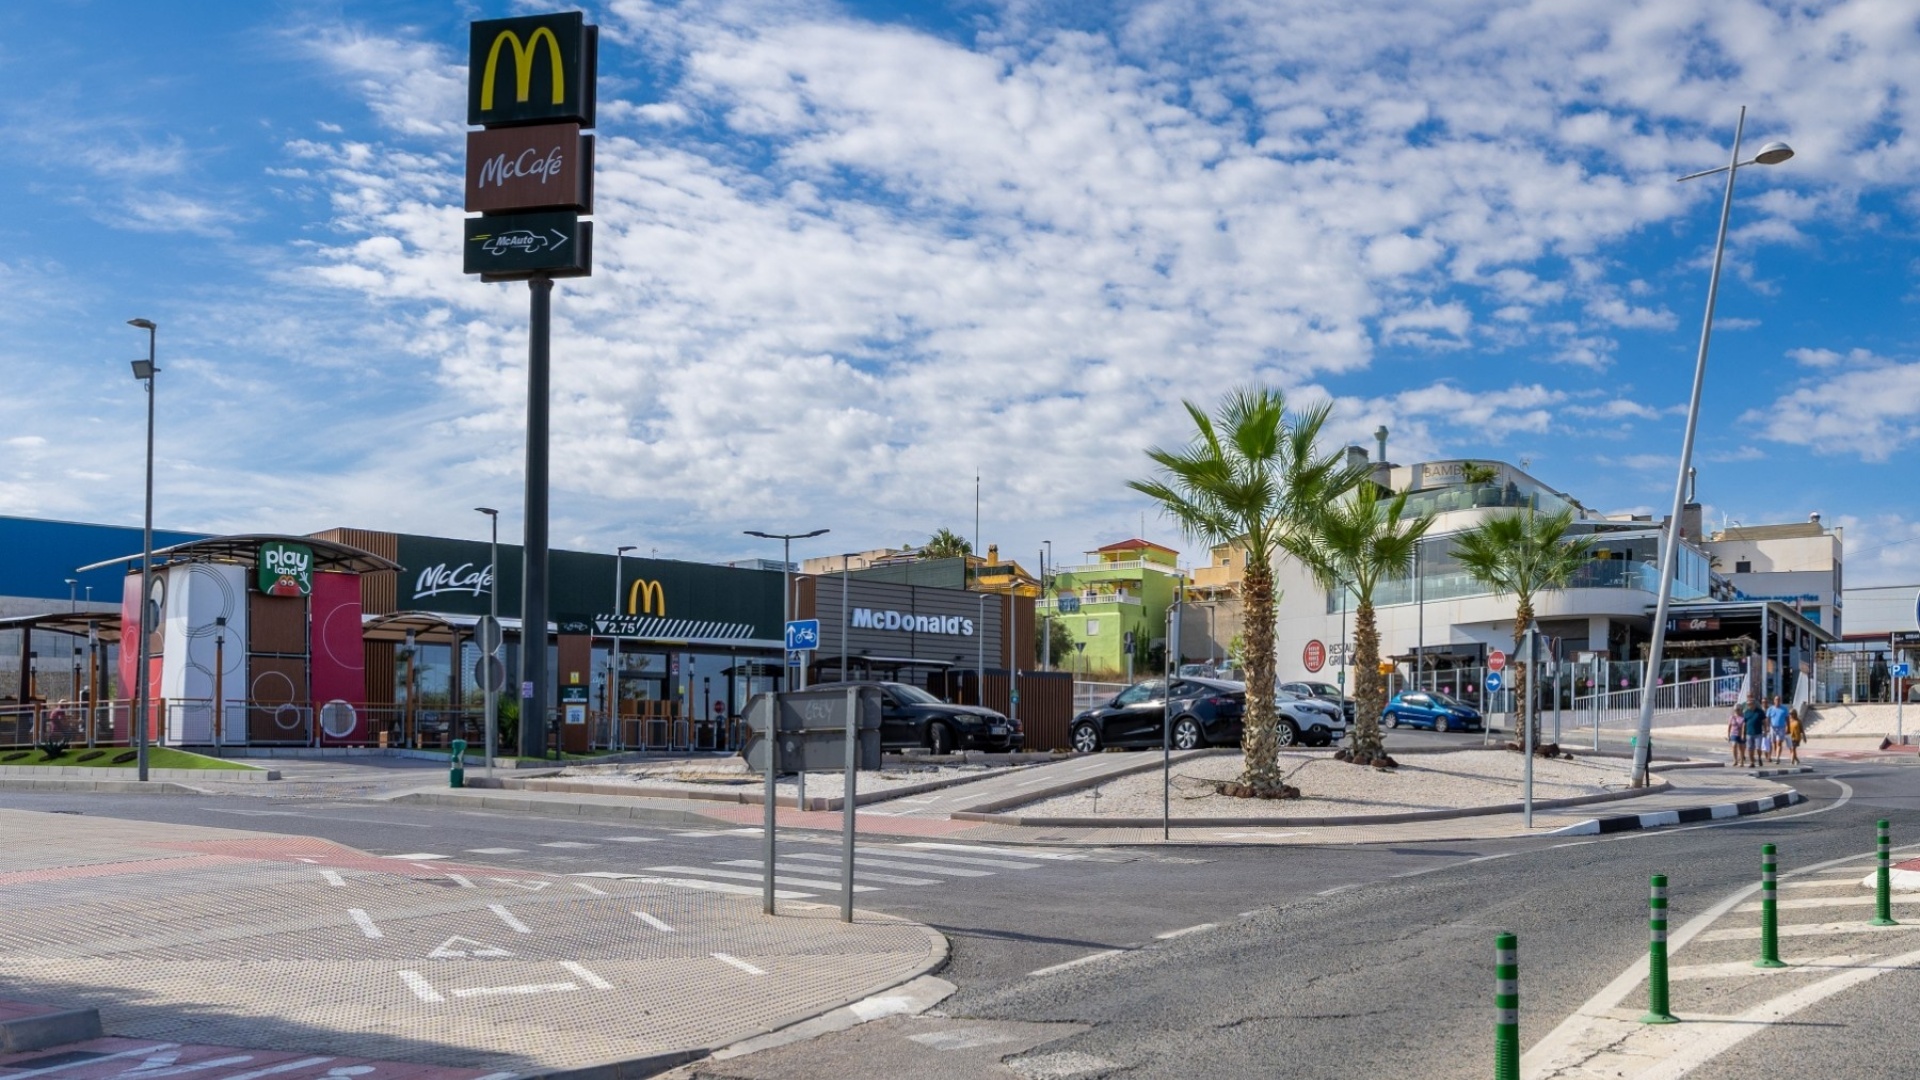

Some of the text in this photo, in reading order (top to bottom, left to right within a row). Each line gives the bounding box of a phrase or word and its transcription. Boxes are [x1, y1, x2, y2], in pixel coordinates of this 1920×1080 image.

[478, 146, 562, 188] McCafé
[496, 236, 534, 246] McAuto
[265, 545, 309, 571] play
[274, 564, 297, 575] land
[608, 622, 635, 633] 2.75
[851, 608, 974, 636] McDonald's
[1893, 665, 1900, 674] P
